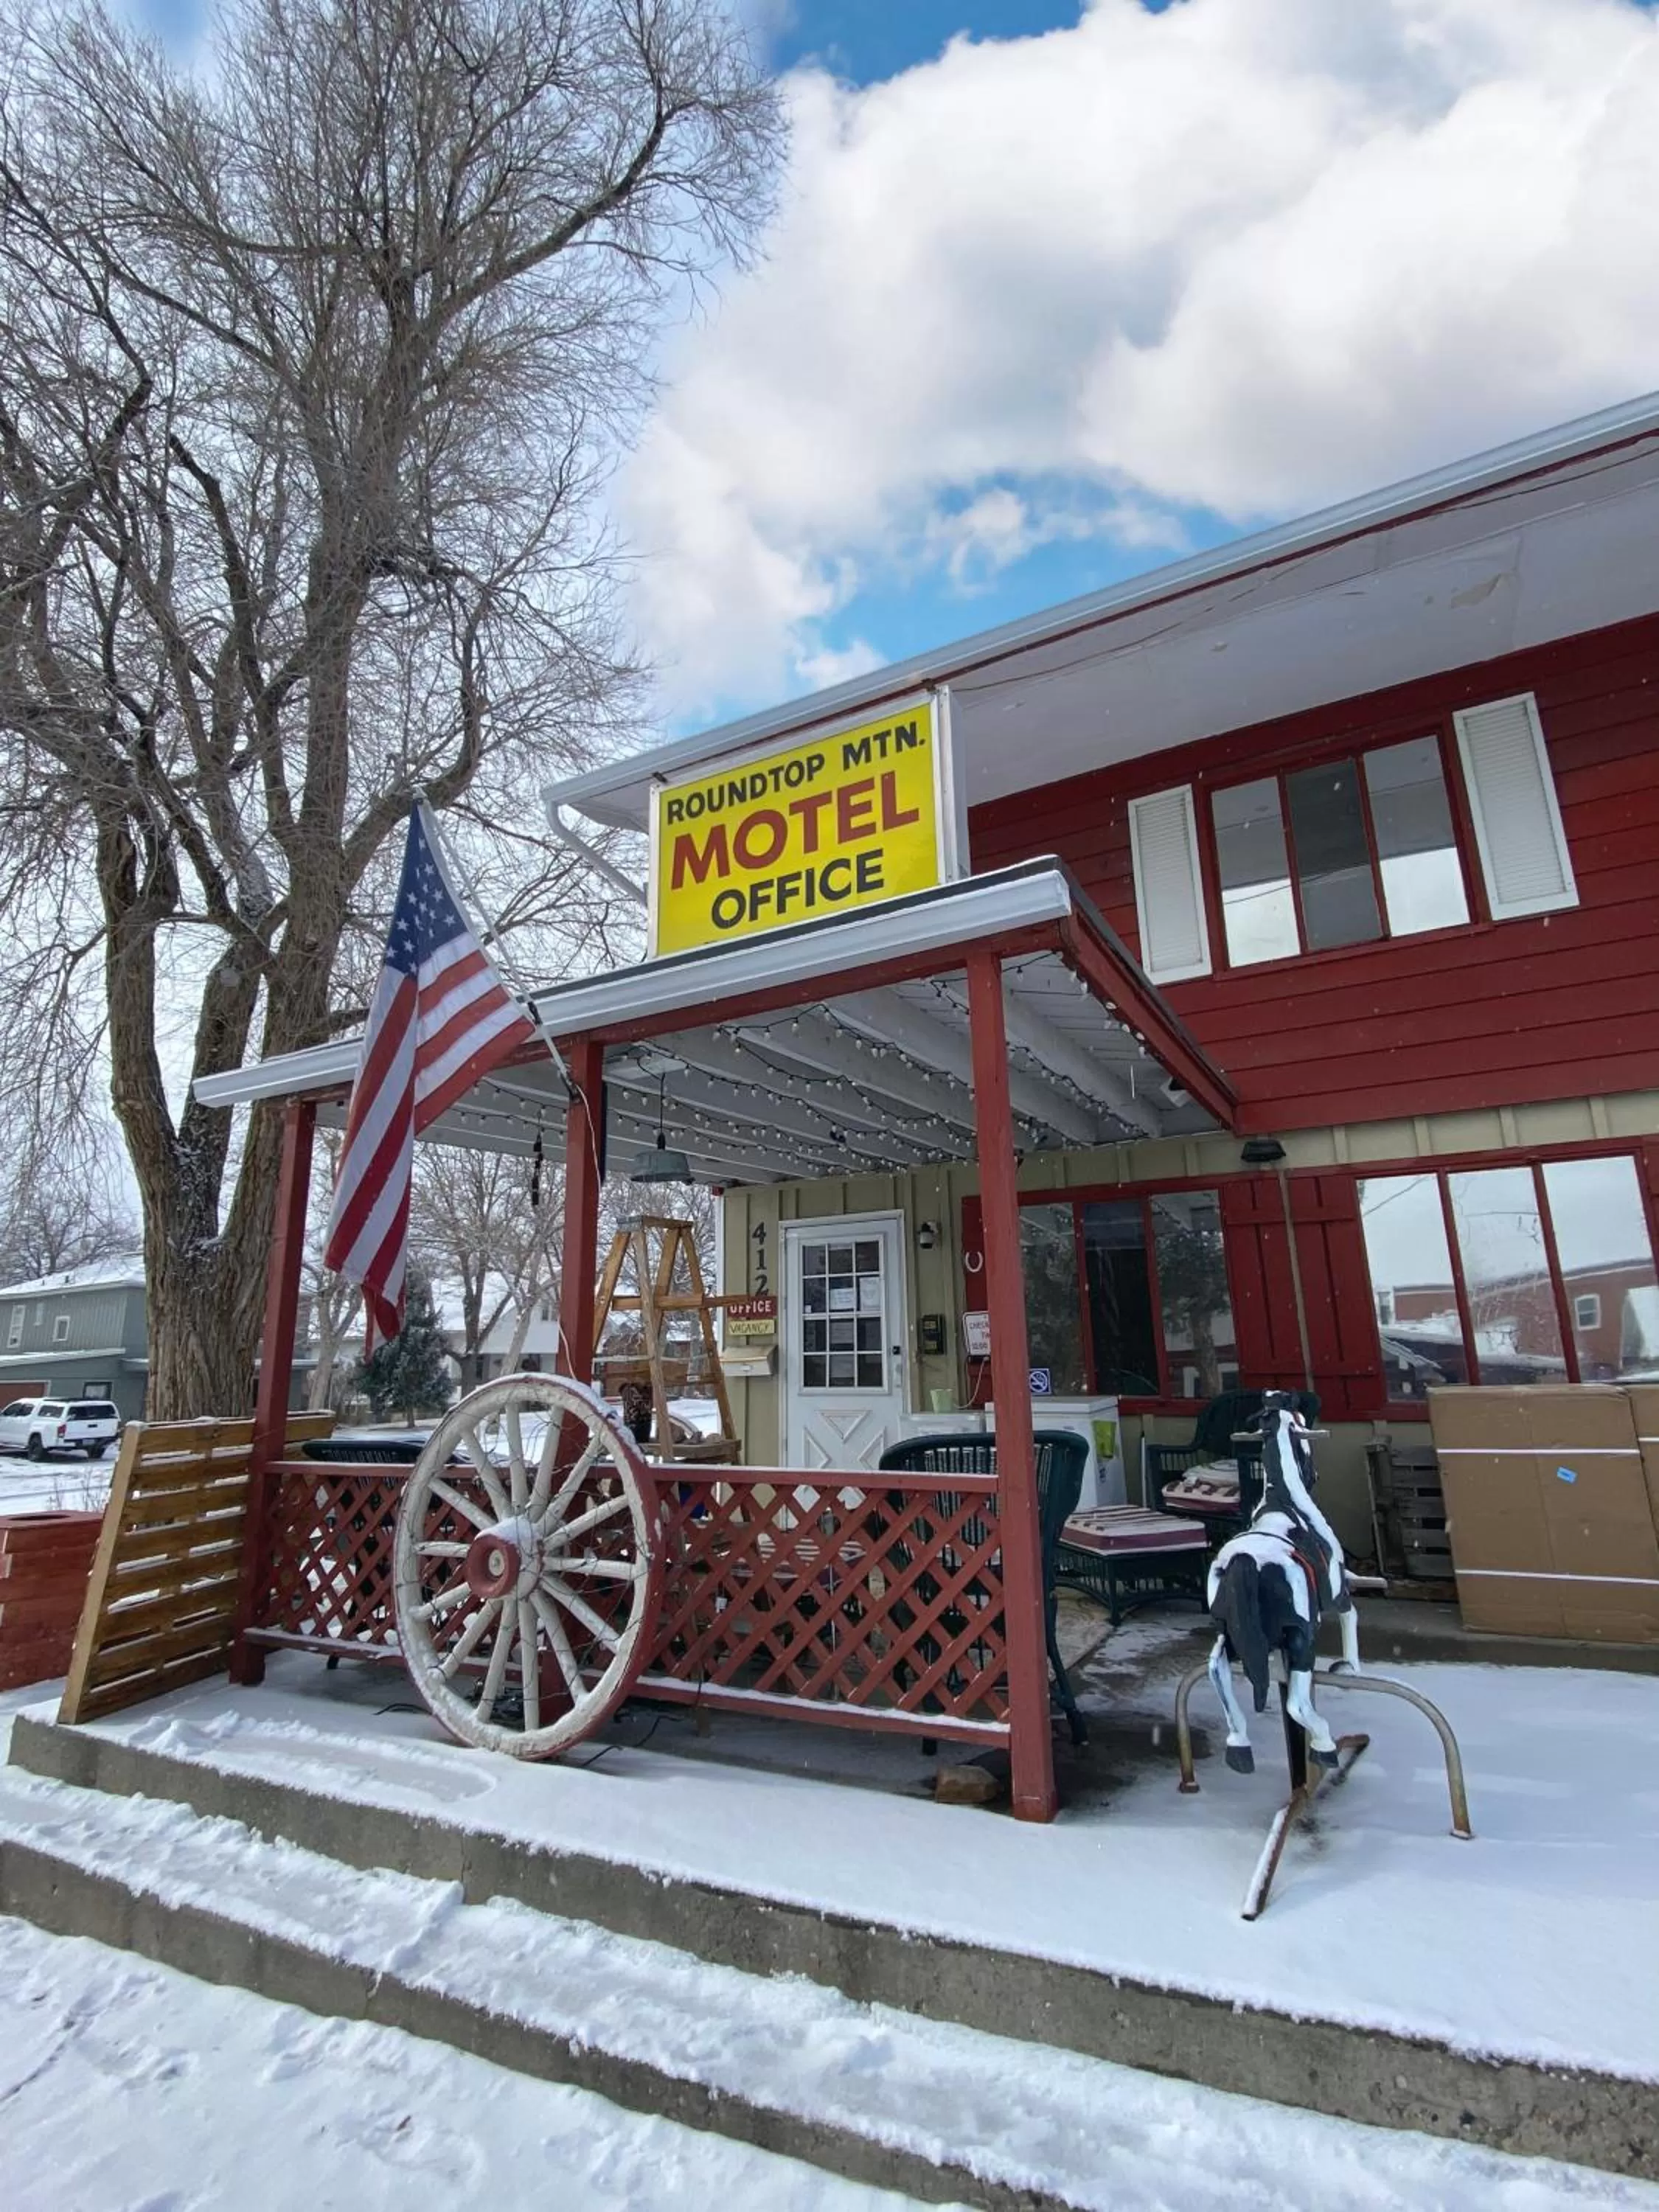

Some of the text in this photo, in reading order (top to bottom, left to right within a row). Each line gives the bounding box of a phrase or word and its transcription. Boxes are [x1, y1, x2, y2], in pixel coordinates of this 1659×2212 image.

[667, 721, 926, 824] ROUNDTOP MTN.
[671, 771, 919, 890] MOTEL
[712, 849, 884, 929] OFFICE
[752, 1221, 769, 1296] 412
[730, 1321, 769, 1335] VACANCY
